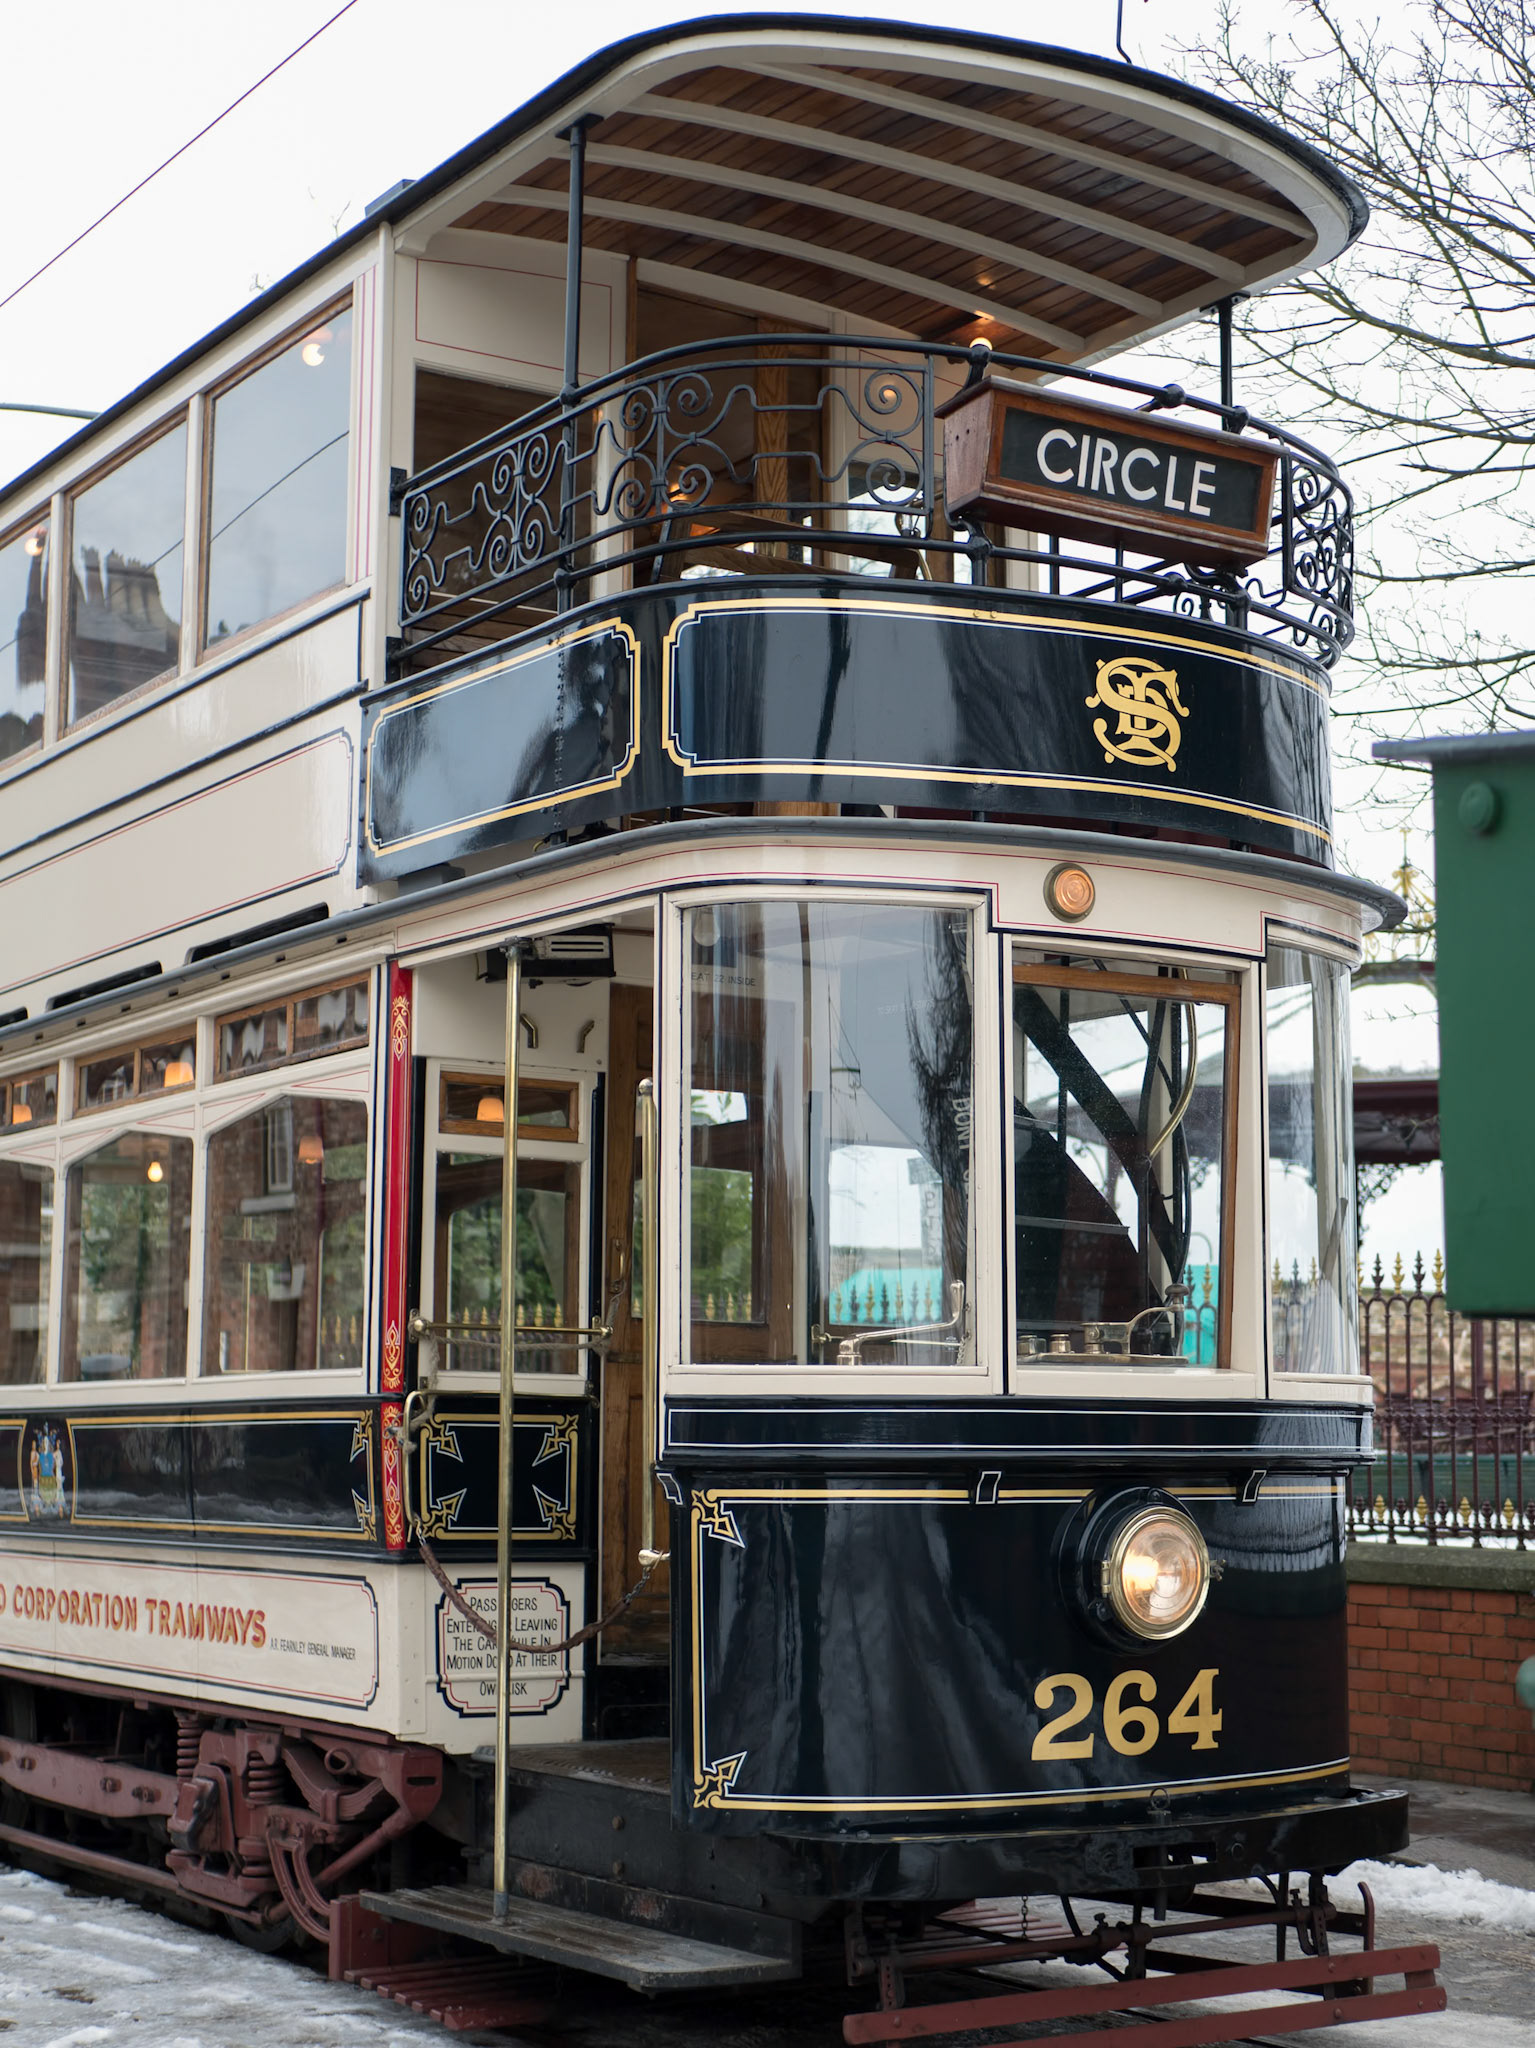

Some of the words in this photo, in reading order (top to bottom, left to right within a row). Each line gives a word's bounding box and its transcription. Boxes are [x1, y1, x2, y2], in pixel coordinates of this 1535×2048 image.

[1037, 428, 1216, 517] CIRCLE
[691, 972, 710, 983] EAT
[728, 975, 757, 987] INSIDE
[471, 1596, 538, 1612] PASSGERS
[13, 1584, 137, 1632] CORPORATION
[145, 1598, 266, 1648] TRAMWAYS
[515, 1616, 558, 1632] LEAVING
[307, 1641, 329, 1657] GENERAL
[331, 1645, 356, 1660] MANAGER
[453, 1636, 473, 1651] THE
[540, 1634, 551, 1647] IN
[446, 1654, 483, 1670] MOTION
[515, 1652, 528, 1667] AT
[480, 1681, 497, 1697] OW
[510, 1682, 528, 1696] ISK
[1031, 1668, 1222, 1761] 264
